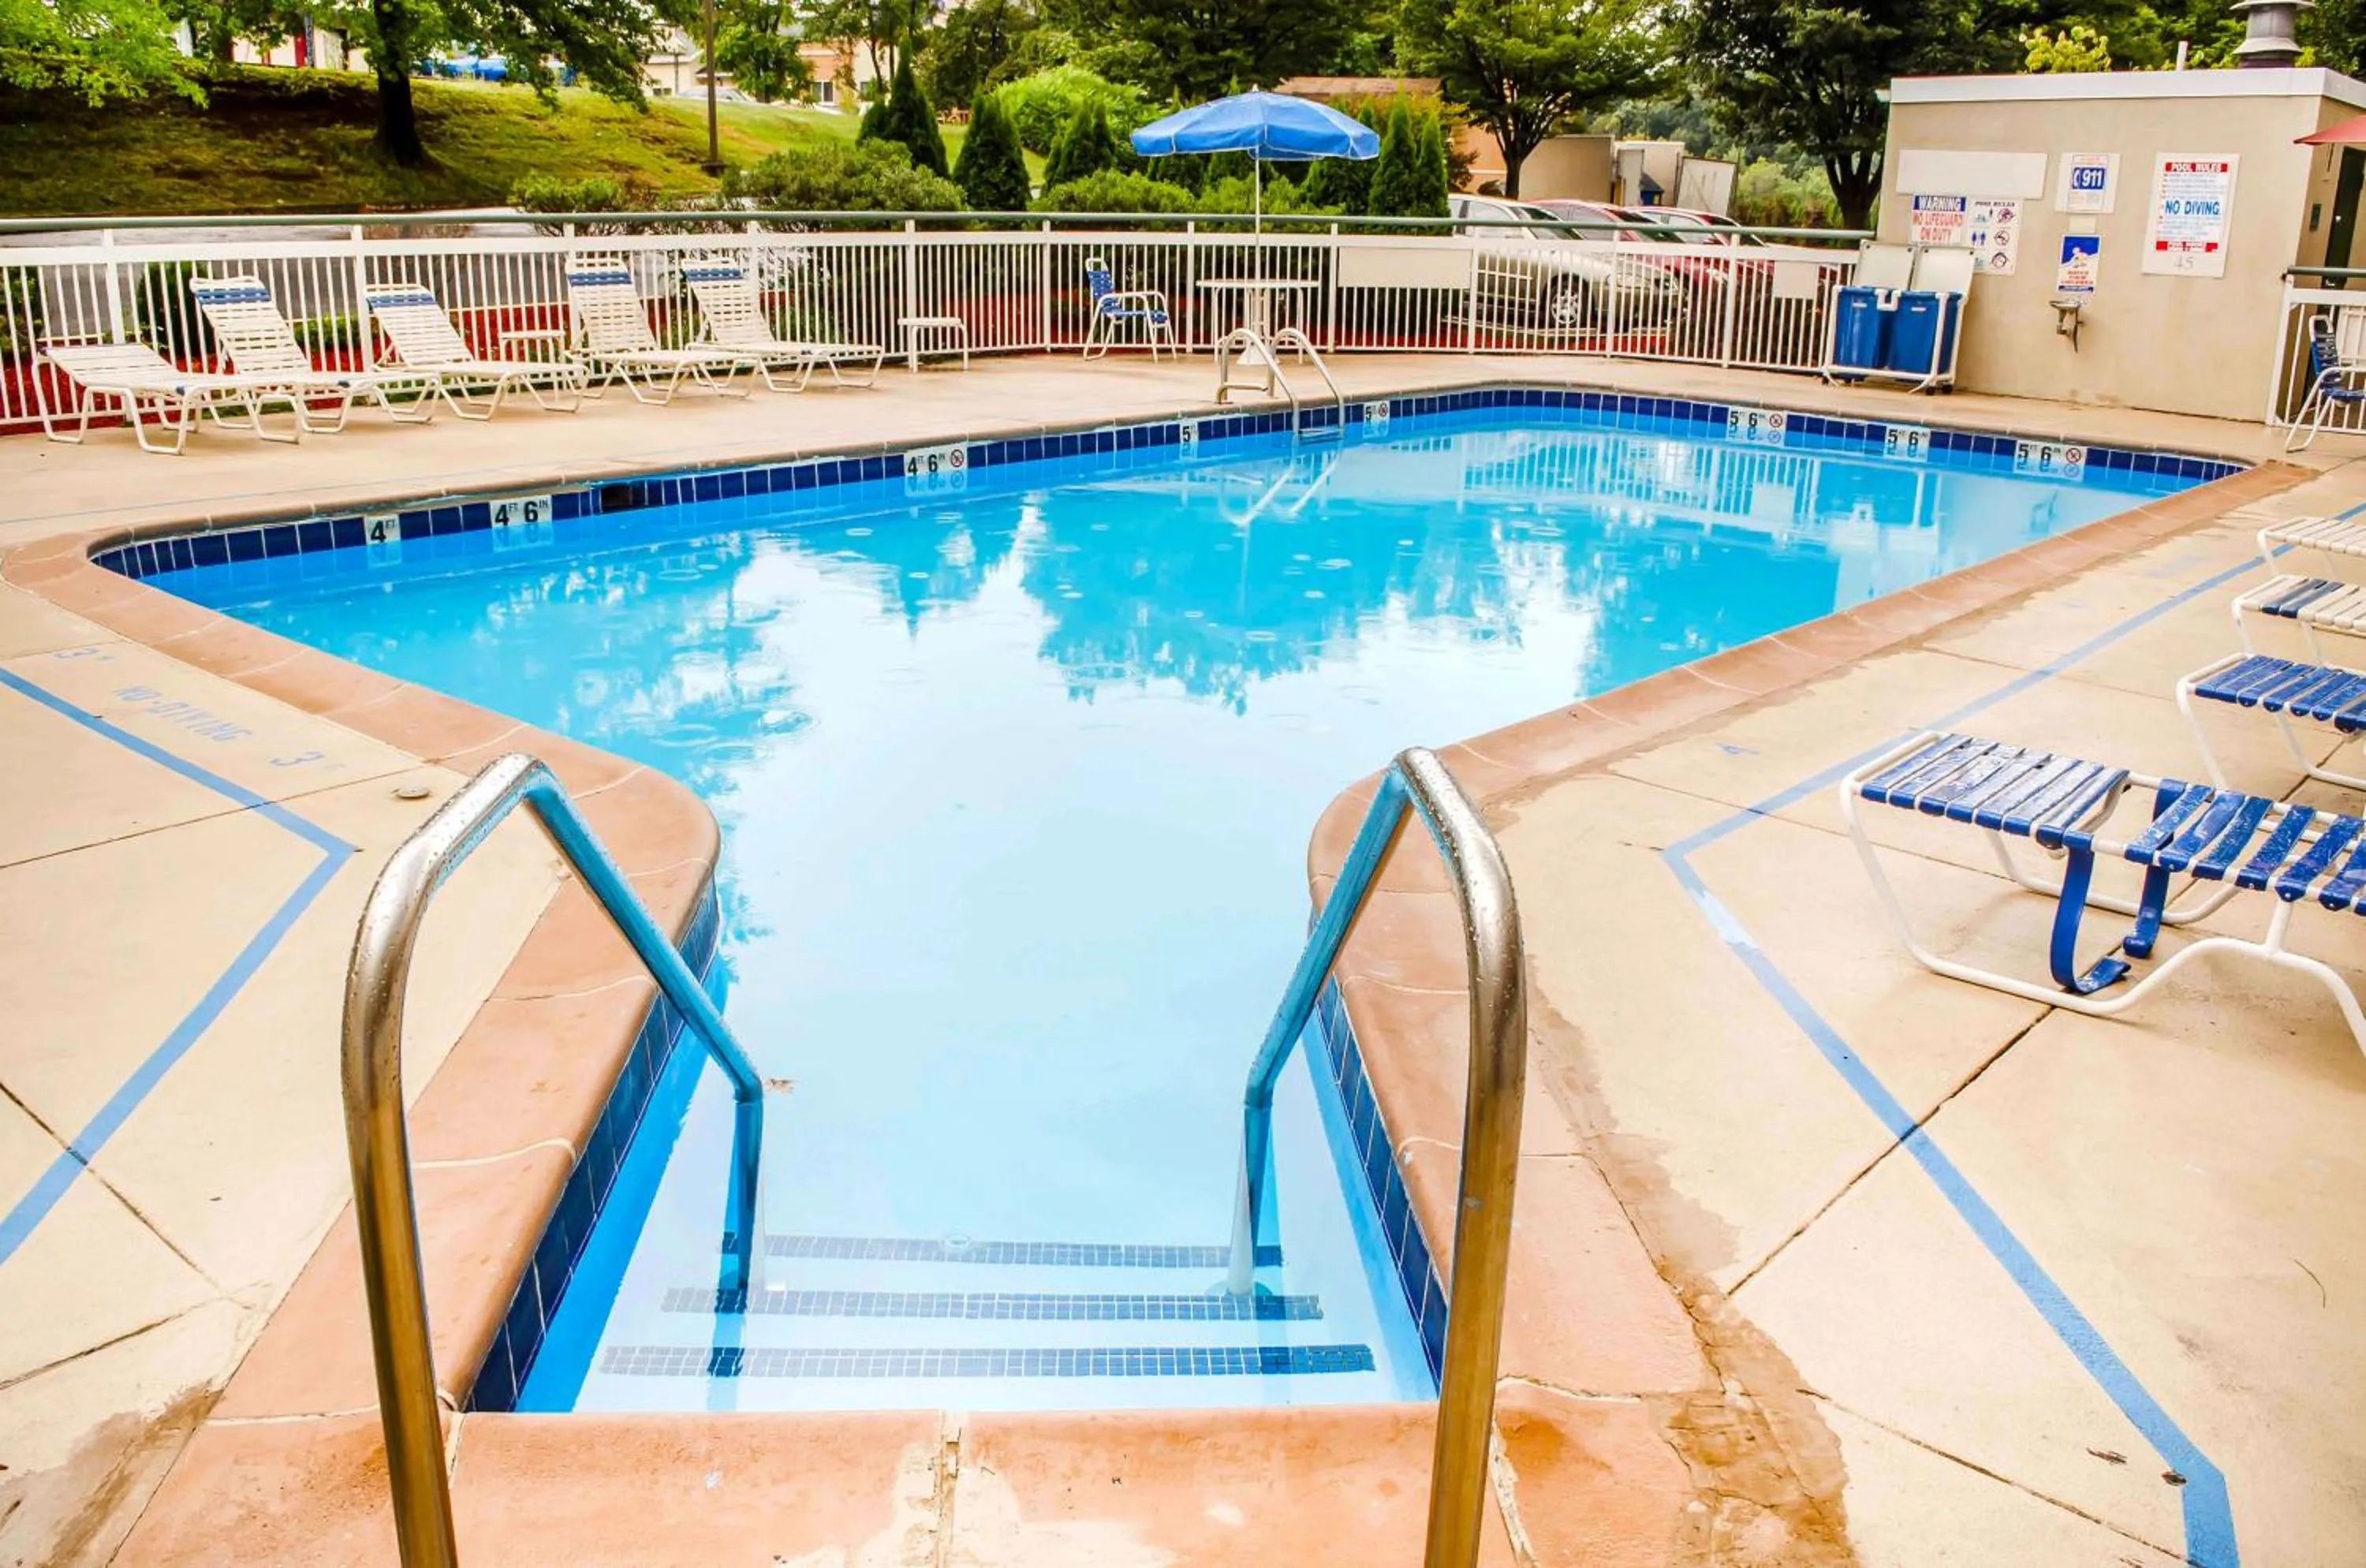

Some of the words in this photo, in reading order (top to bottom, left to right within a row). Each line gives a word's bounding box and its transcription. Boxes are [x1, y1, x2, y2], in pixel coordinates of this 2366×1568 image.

[2171, 162, 2192, 173] POOL
[2195, 162, 2222, 173] RULES
[2081, 169, 2103, 188] 911
[1918, 196, 1961, 211] WARNING
[2165, 200, 2181, 215] NO
[2184, 200, 2220, 215] DIVING
[1913, 212, 1924, 226] NO
[1924, 212, 1963, 227] LIFEGUARD
[1920, 226, 1931, 240] ON
[1931, 226, 1952, 241] DUTY
[494, 504, 509, 526] 4
[524, 501, 539, 523] 6
[371, 520, 386, 543] 4
